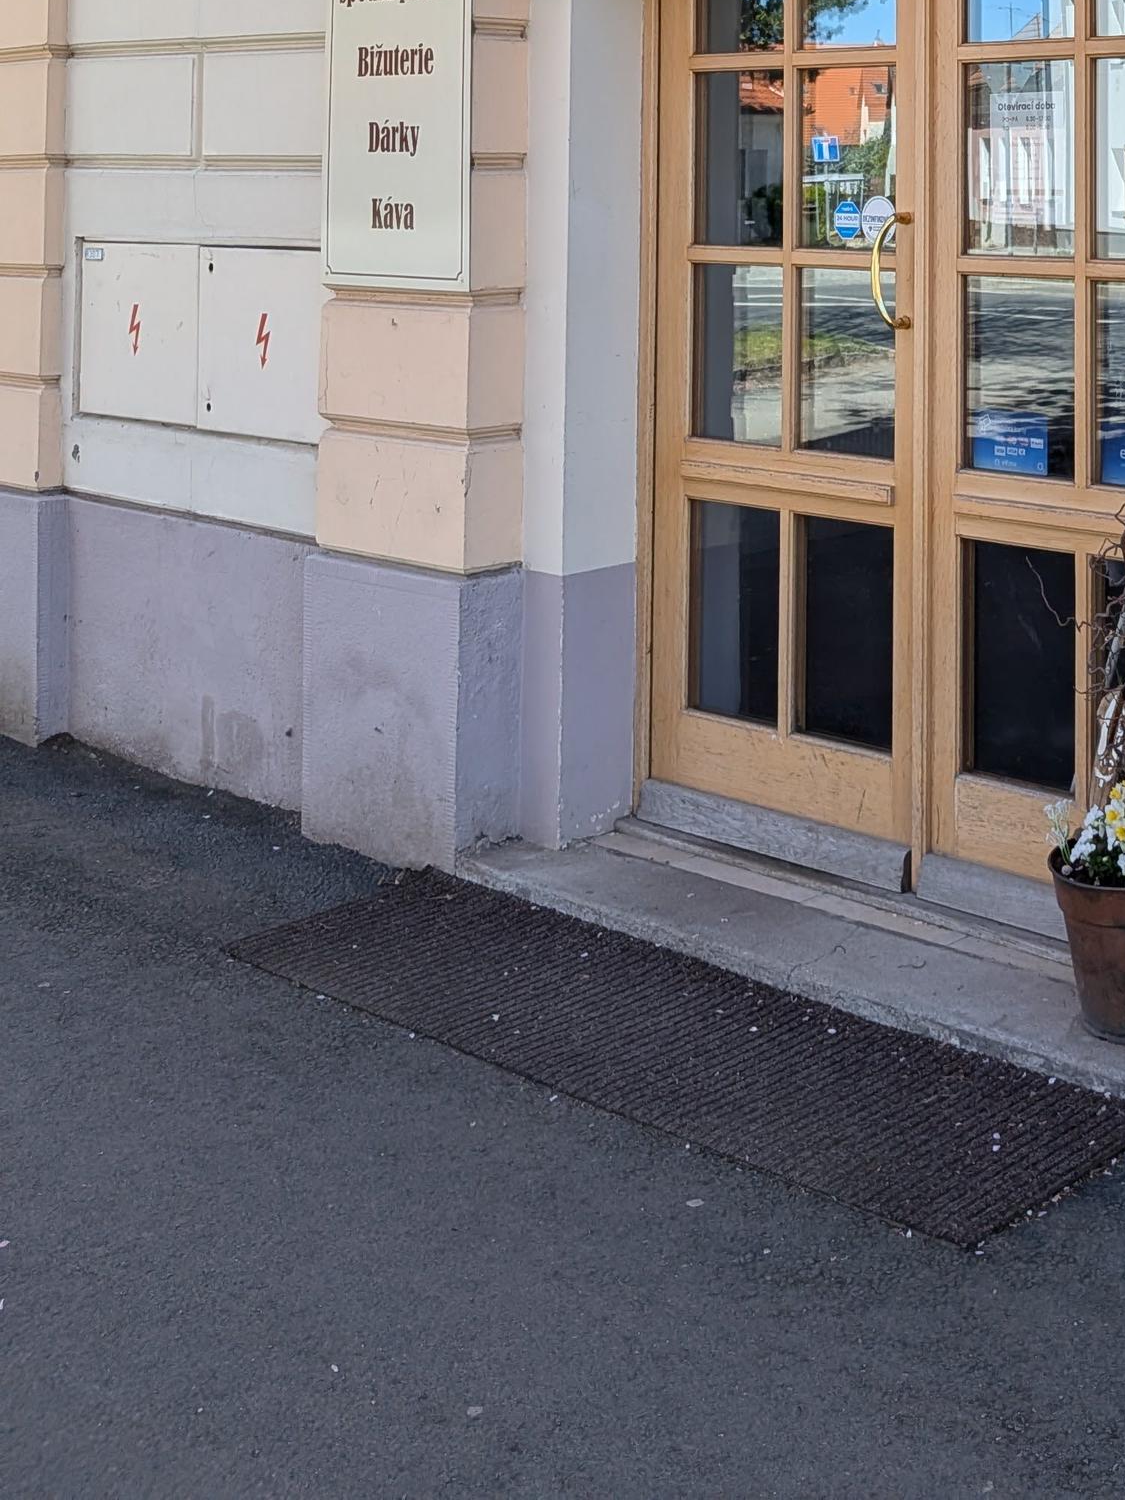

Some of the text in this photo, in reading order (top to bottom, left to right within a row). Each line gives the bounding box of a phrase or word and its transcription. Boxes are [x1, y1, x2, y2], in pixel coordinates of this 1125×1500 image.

[357, 42, 434, 78] Bižuterie
[997, 100, 1034, 111] Otevírací
[367, 119, 420, 157] Dárky
[371, 196, 415, 230] Káva
